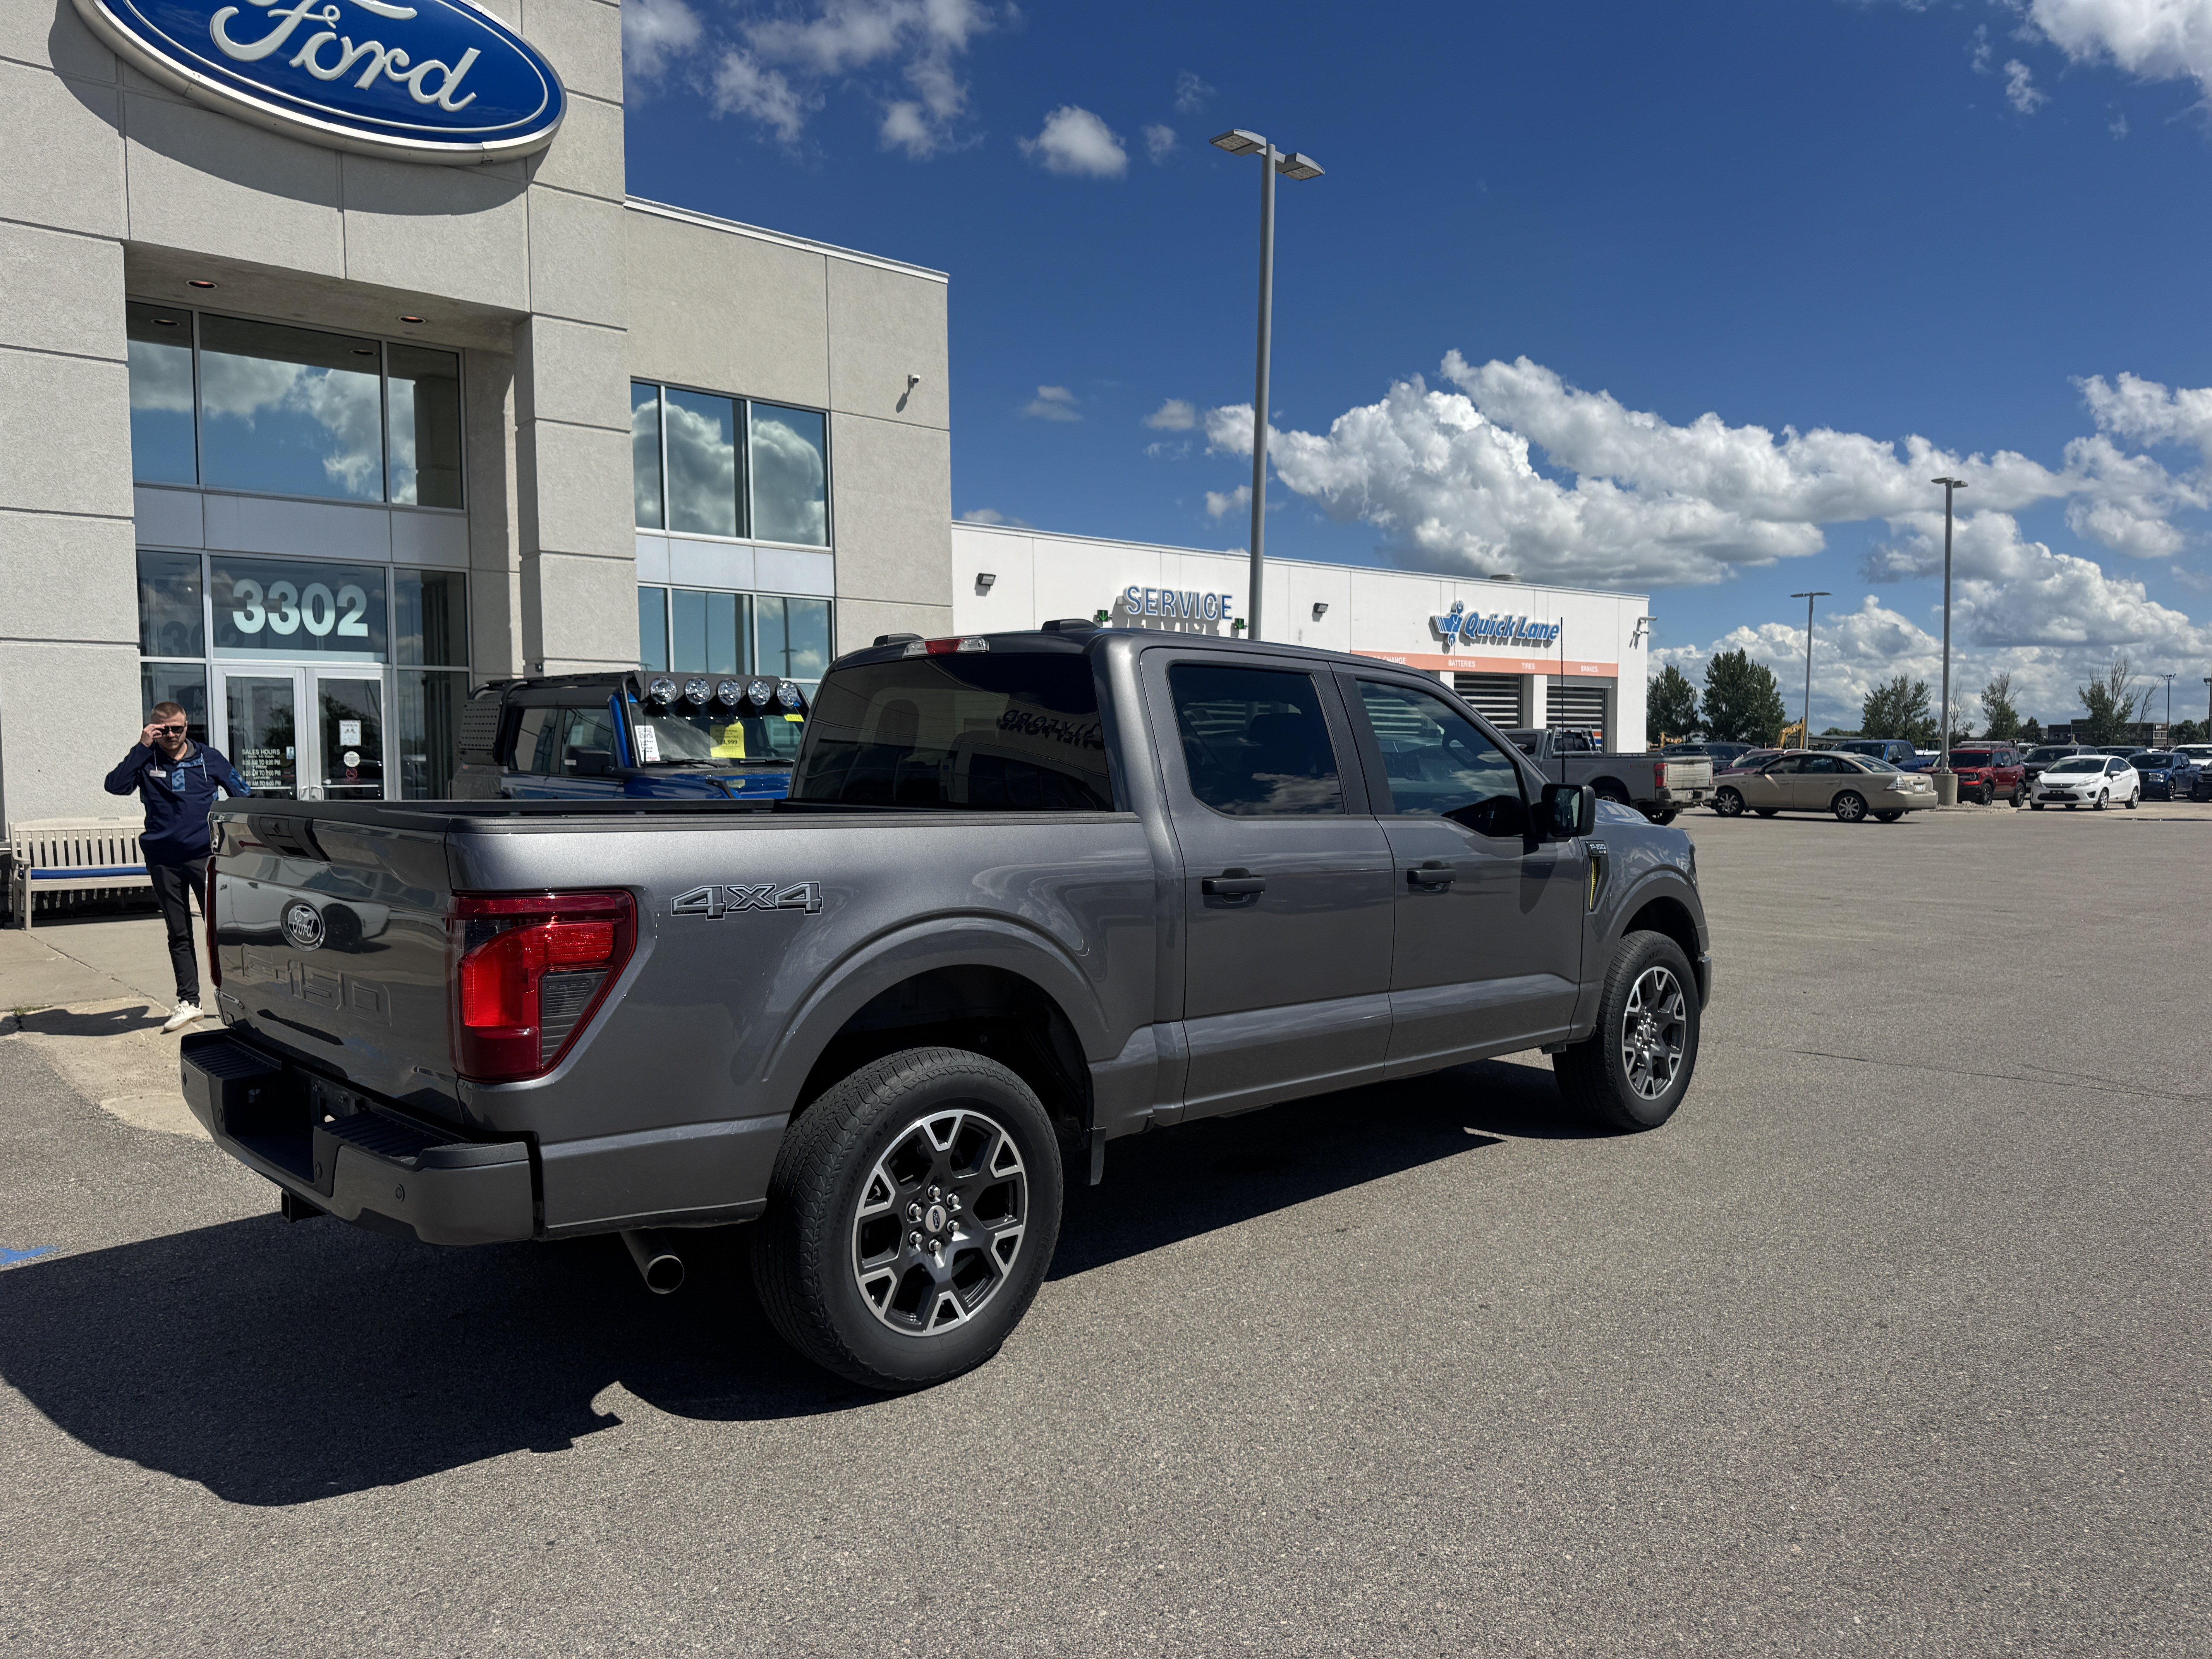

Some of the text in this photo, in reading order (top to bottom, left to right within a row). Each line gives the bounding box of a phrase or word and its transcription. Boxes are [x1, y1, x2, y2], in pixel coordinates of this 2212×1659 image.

[210, 0, 481, 112] Ford
[233, 579, 368, 637] 3302
[1125, 586, 1233, 620] SERVICE
[1464, 612, 1559, 640] Quick Lane
[293, 910, 314, 938] Ford
